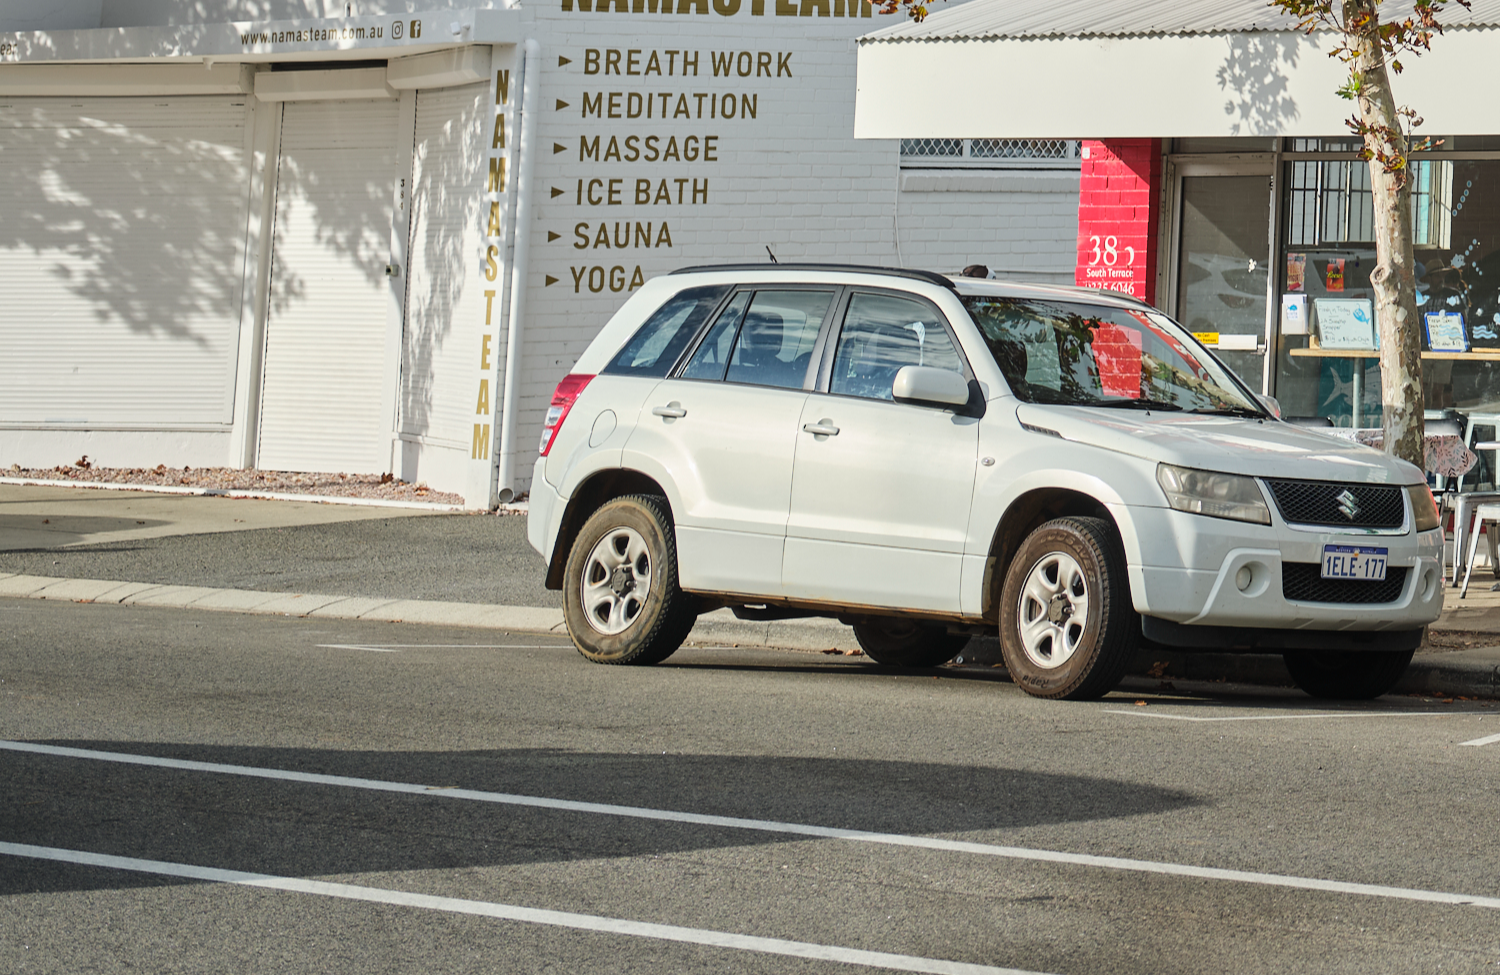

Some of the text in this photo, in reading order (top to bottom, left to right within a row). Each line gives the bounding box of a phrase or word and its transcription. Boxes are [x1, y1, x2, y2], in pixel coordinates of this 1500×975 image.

[240, 26, 384, 46] www.namasteam.com.au
[583, 48, 793, 78] BREATH WORK
[581, 91, 758, 119] MEDITATION
[579, 135, 719, 162] MASSAGE
[576, 178, 709, 205] ICE BATH
[573, 221, 673, 250] SAUNA
[472, 69, 510, 460] NAMASTEAM
[1086, 268, 1134, 278] South Terrace
[570, 265, 645, 293] YOGA
